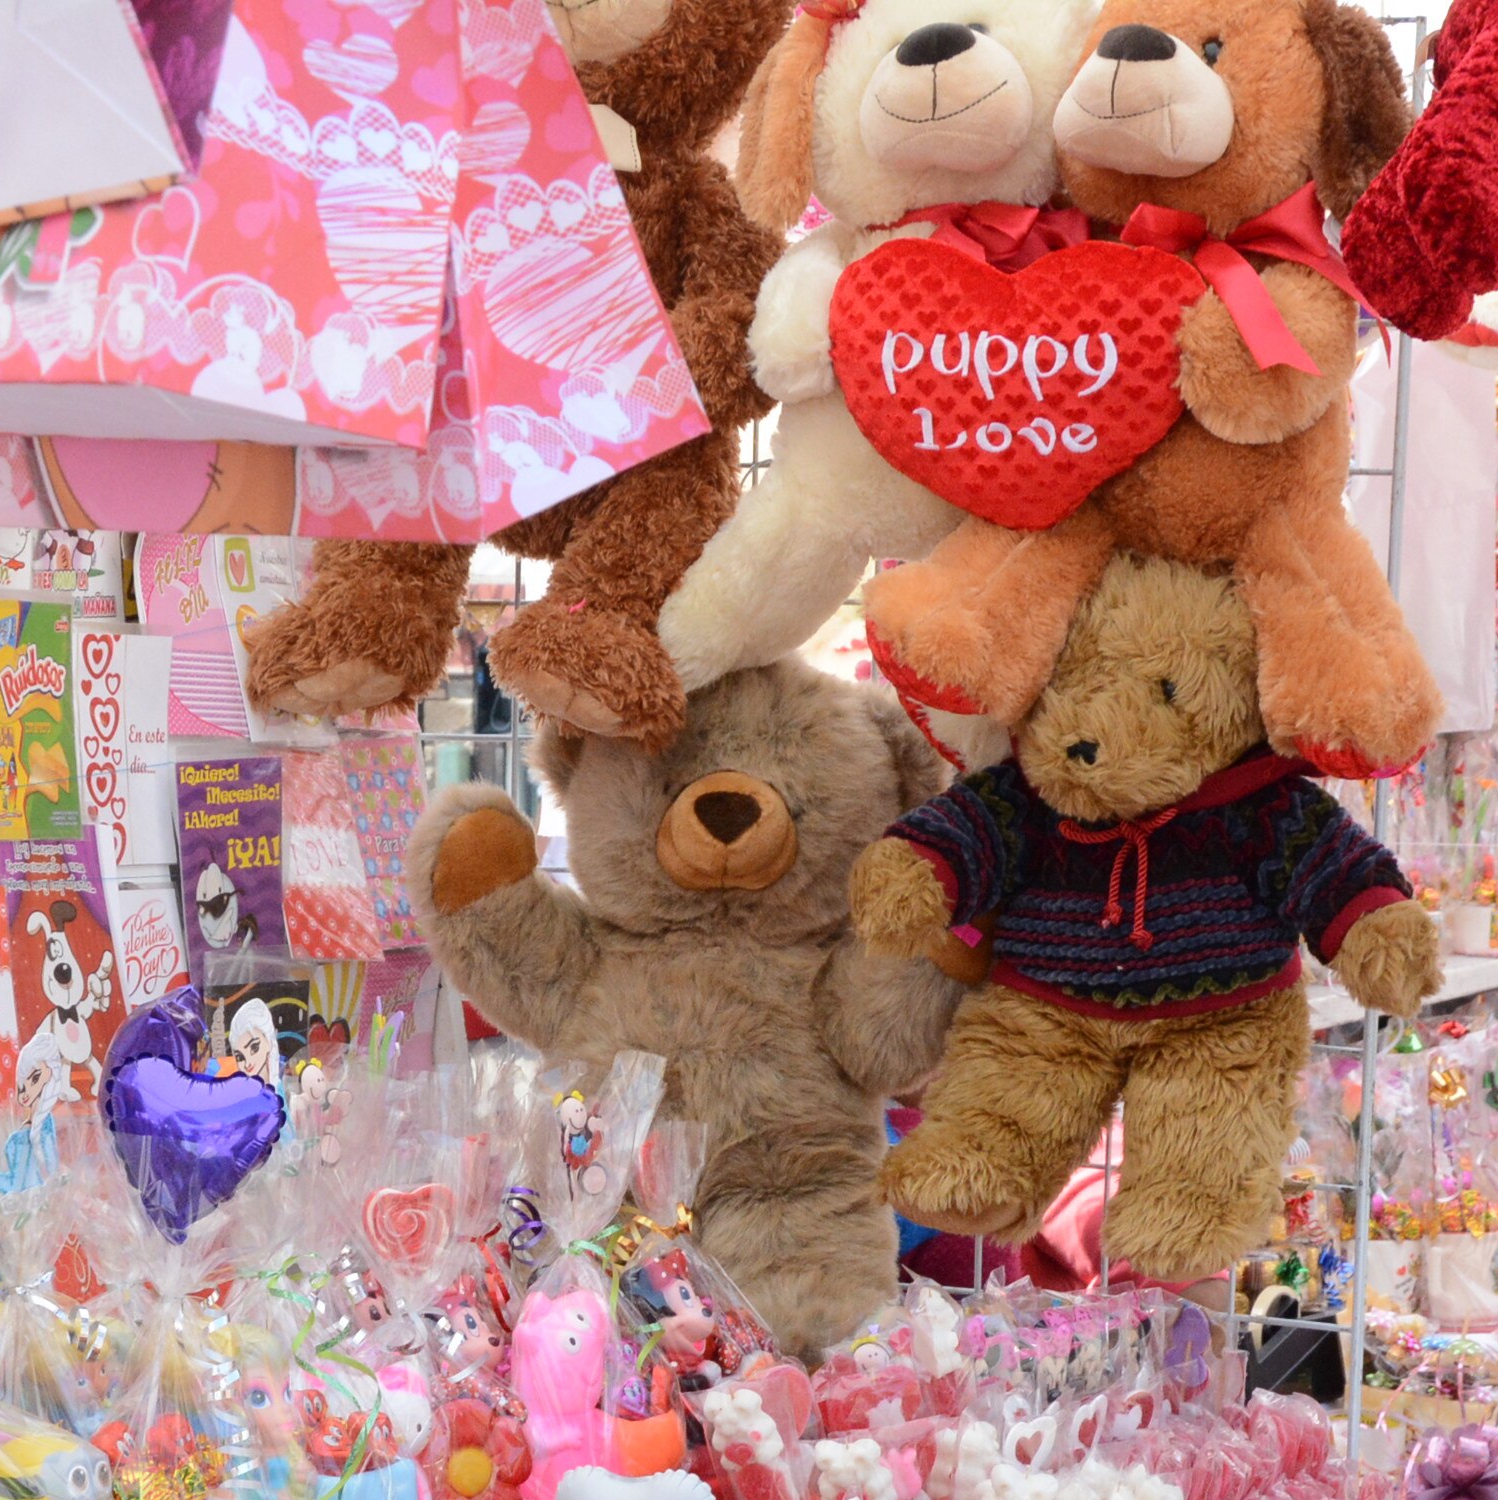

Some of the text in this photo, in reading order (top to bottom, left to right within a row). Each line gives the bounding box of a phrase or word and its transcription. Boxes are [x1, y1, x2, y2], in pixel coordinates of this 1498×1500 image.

[880, 328, 1119, 400] puppy
[911, 406, 1099, 457] Love
[83, 592, 117, 618] MAÑANA
[0, 643, 67, 717] Ruidosos
[128, 724, 166, 745] En este
[179, 763, 240, 785] ¡Quiero!
[206, 781, 281, 805] ¡Necesito!
[184, 808, 239, 830] ¡Ahora!
[226, 834, 281, 871] ¡YA!
[374, 834, 400, 853] Para
[125, 945, 165, 998] Day
